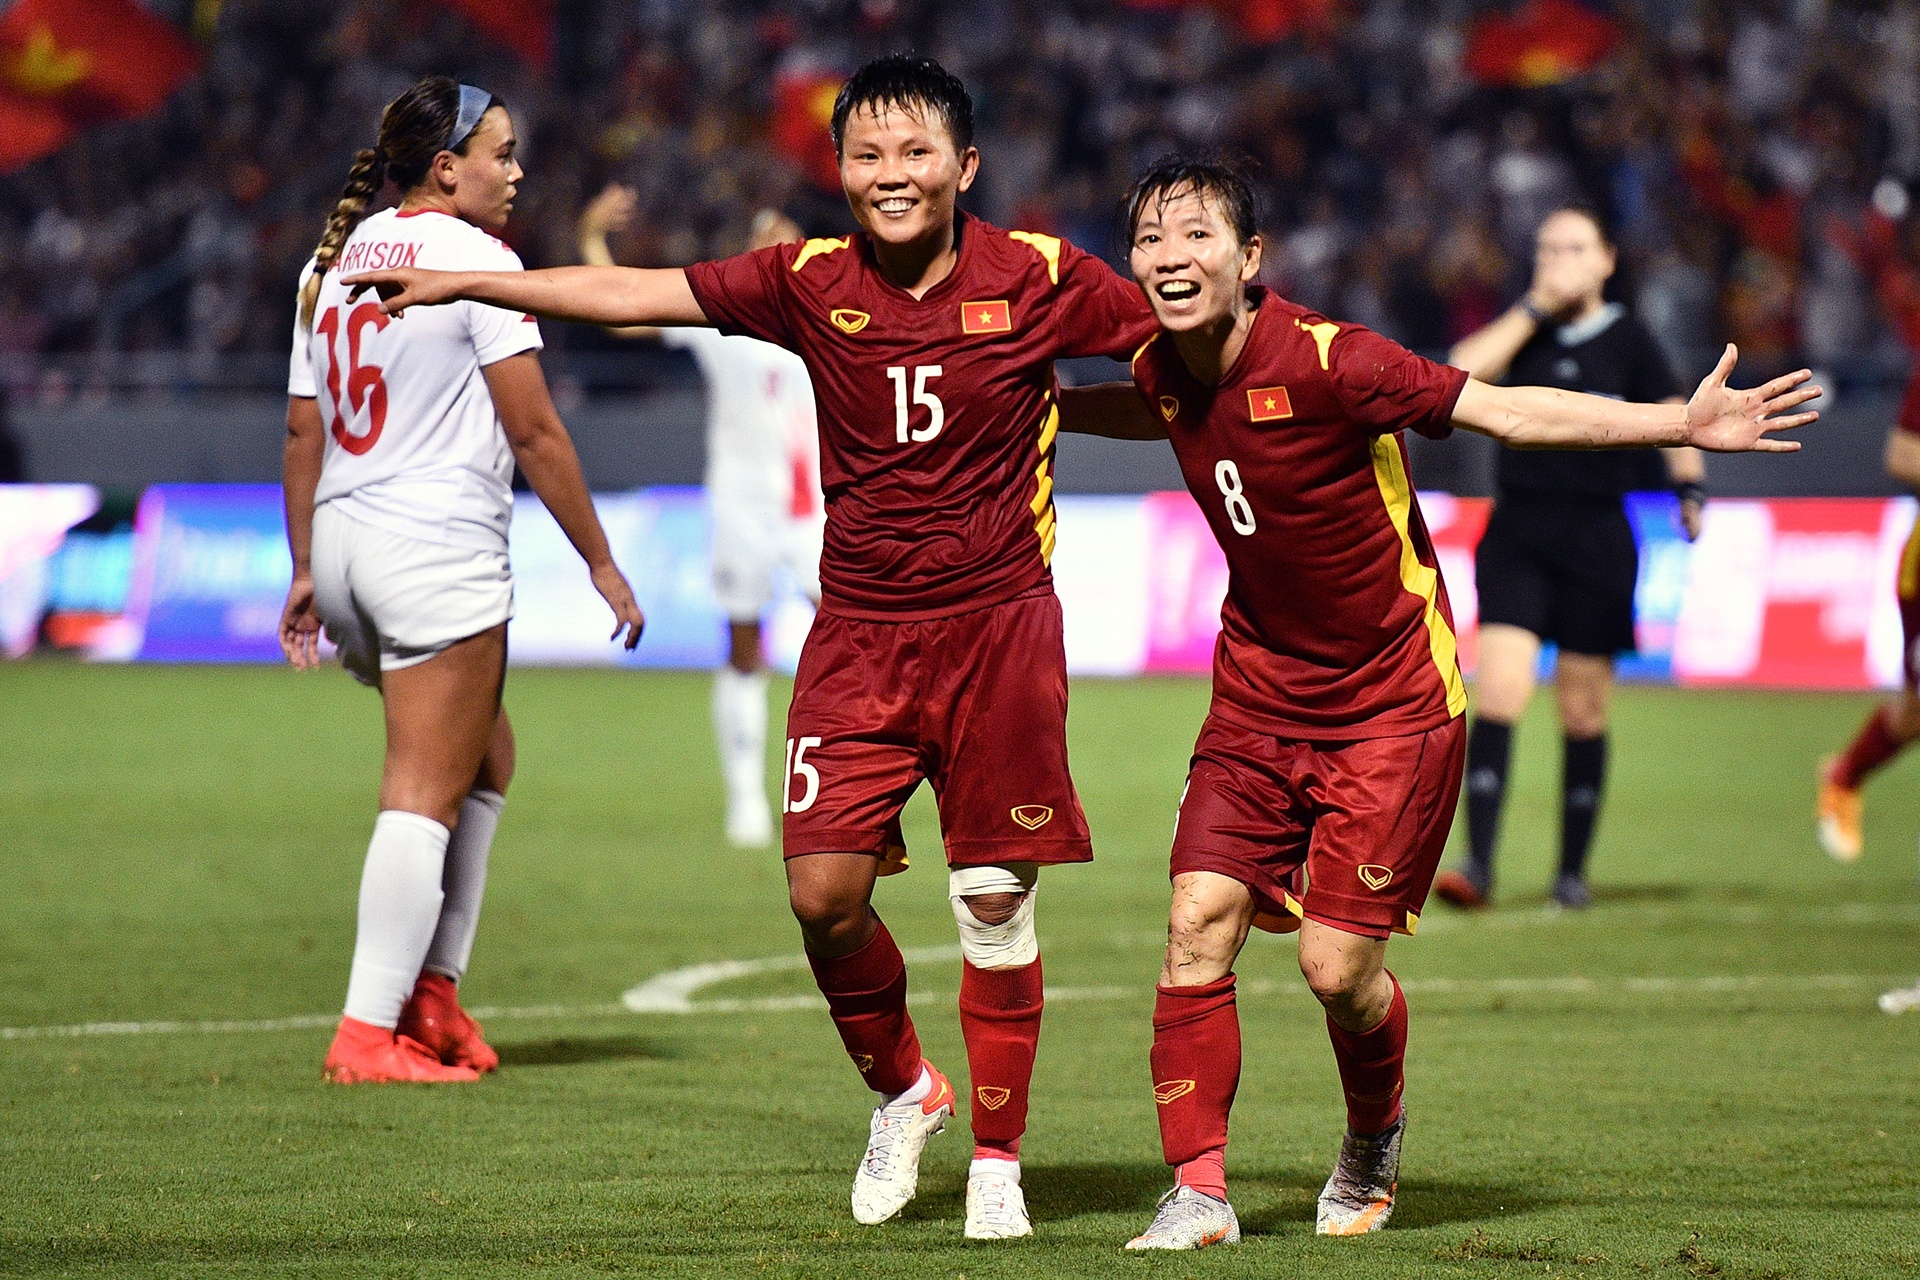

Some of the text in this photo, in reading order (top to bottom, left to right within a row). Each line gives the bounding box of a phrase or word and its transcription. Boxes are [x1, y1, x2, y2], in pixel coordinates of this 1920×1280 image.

[327, 241, 424, 273] ARRISON
[316, 302, 392, 456] 16
[886, 364, 945, 444] 15
[1214, 459, 1257, 536] 8
[782, 736, 823, 815] 15
